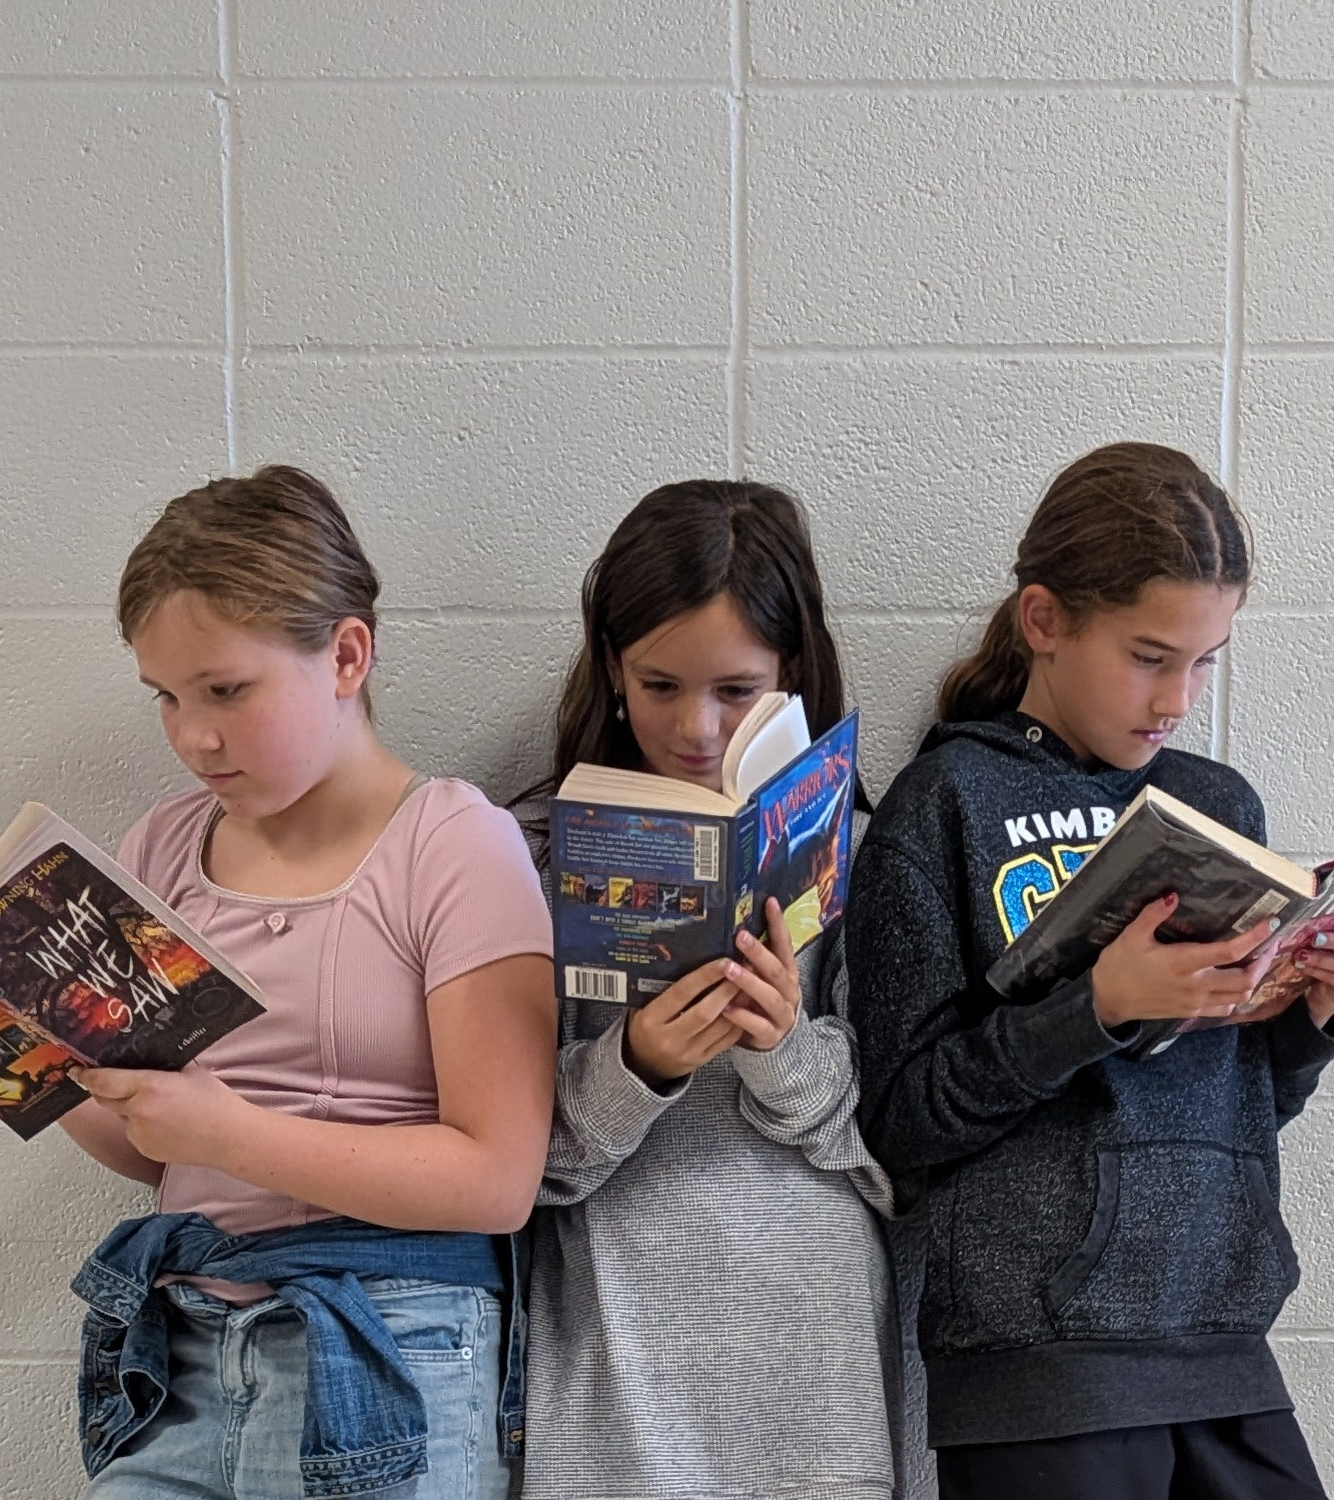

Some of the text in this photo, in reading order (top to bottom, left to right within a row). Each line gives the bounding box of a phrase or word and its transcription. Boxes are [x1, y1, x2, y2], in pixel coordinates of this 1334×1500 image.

[30, 850, 69, 881] HAHN
[25, 884, 110, 980] WHAT
[77, 938, 134, 998] WE
[107, 957, 180, 1033] SAW
